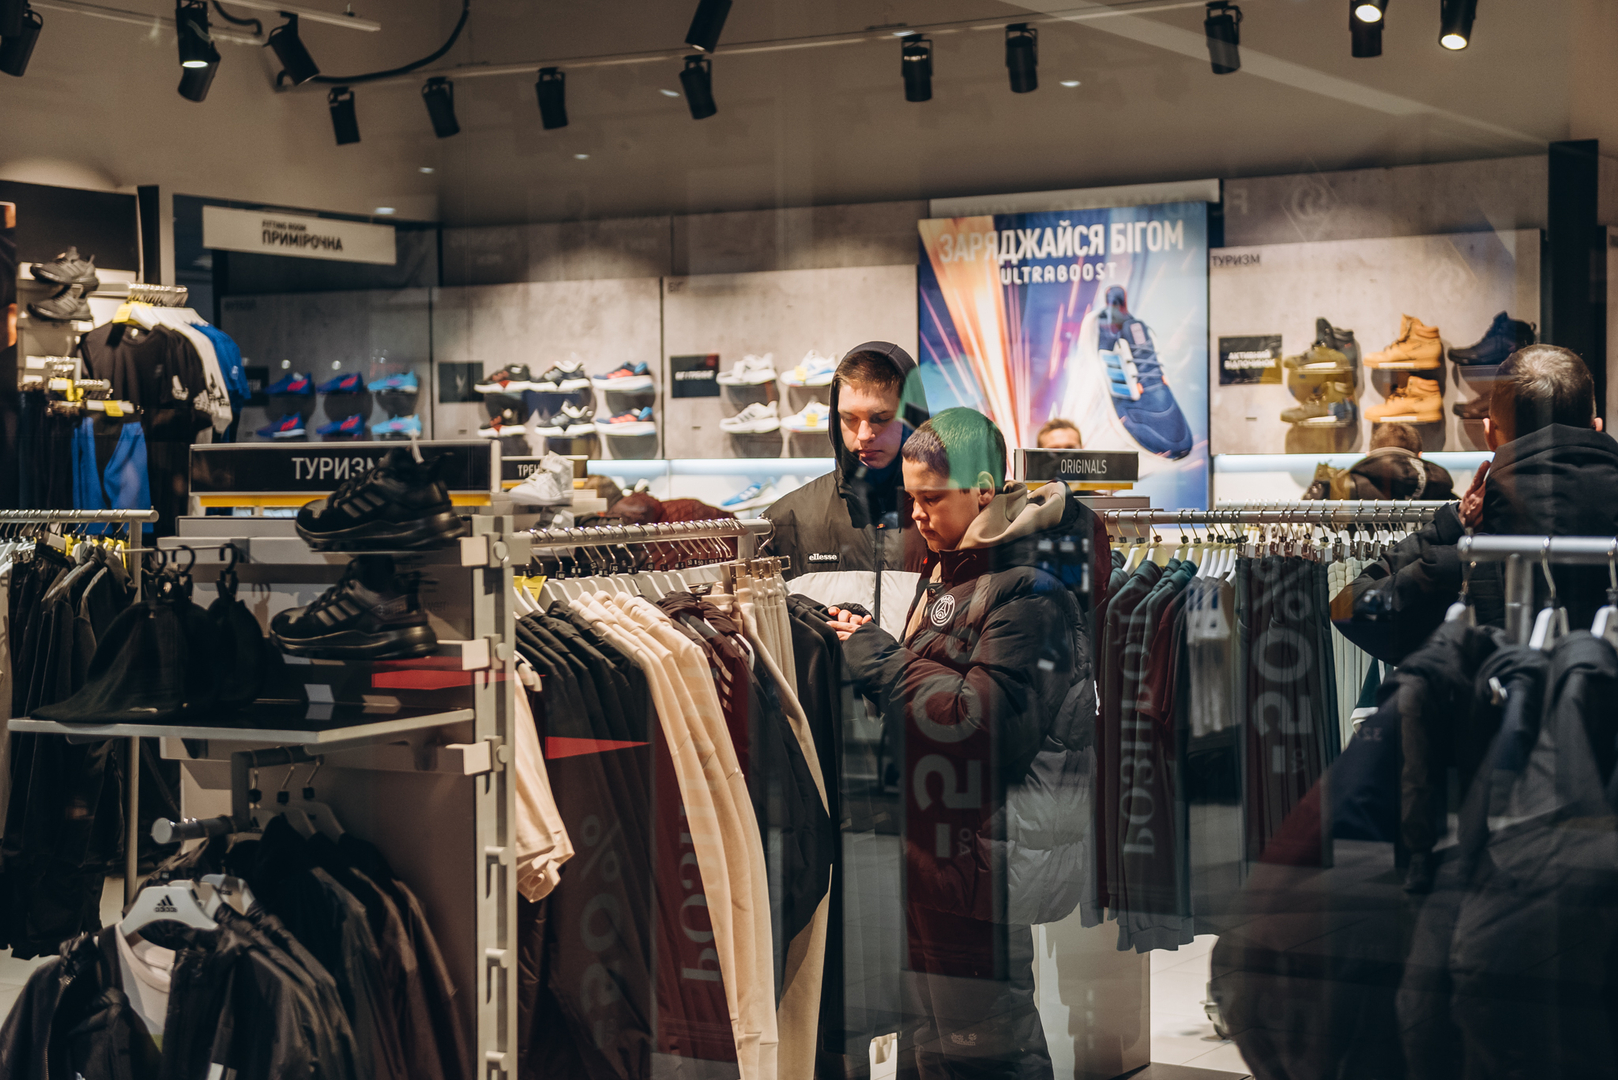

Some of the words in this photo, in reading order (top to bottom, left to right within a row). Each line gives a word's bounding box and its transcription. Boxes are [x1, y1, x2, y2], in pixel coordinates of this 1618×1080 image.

[262, 229, 344, 251] ПРИМІРОЧНА
[938, 220, 1105, 265] ЗАРЯДЖАЙСЯ
[1110, 219, 1185, 256] БІГОМ
[1210, 253, 1261, 267] ТУРИЗМ
[1000, 262, 1117, 286] ULTRABOOST
[1060, 458, 1107, 475] ORIGINALS
[808, 553, 838, 561] ellesse
